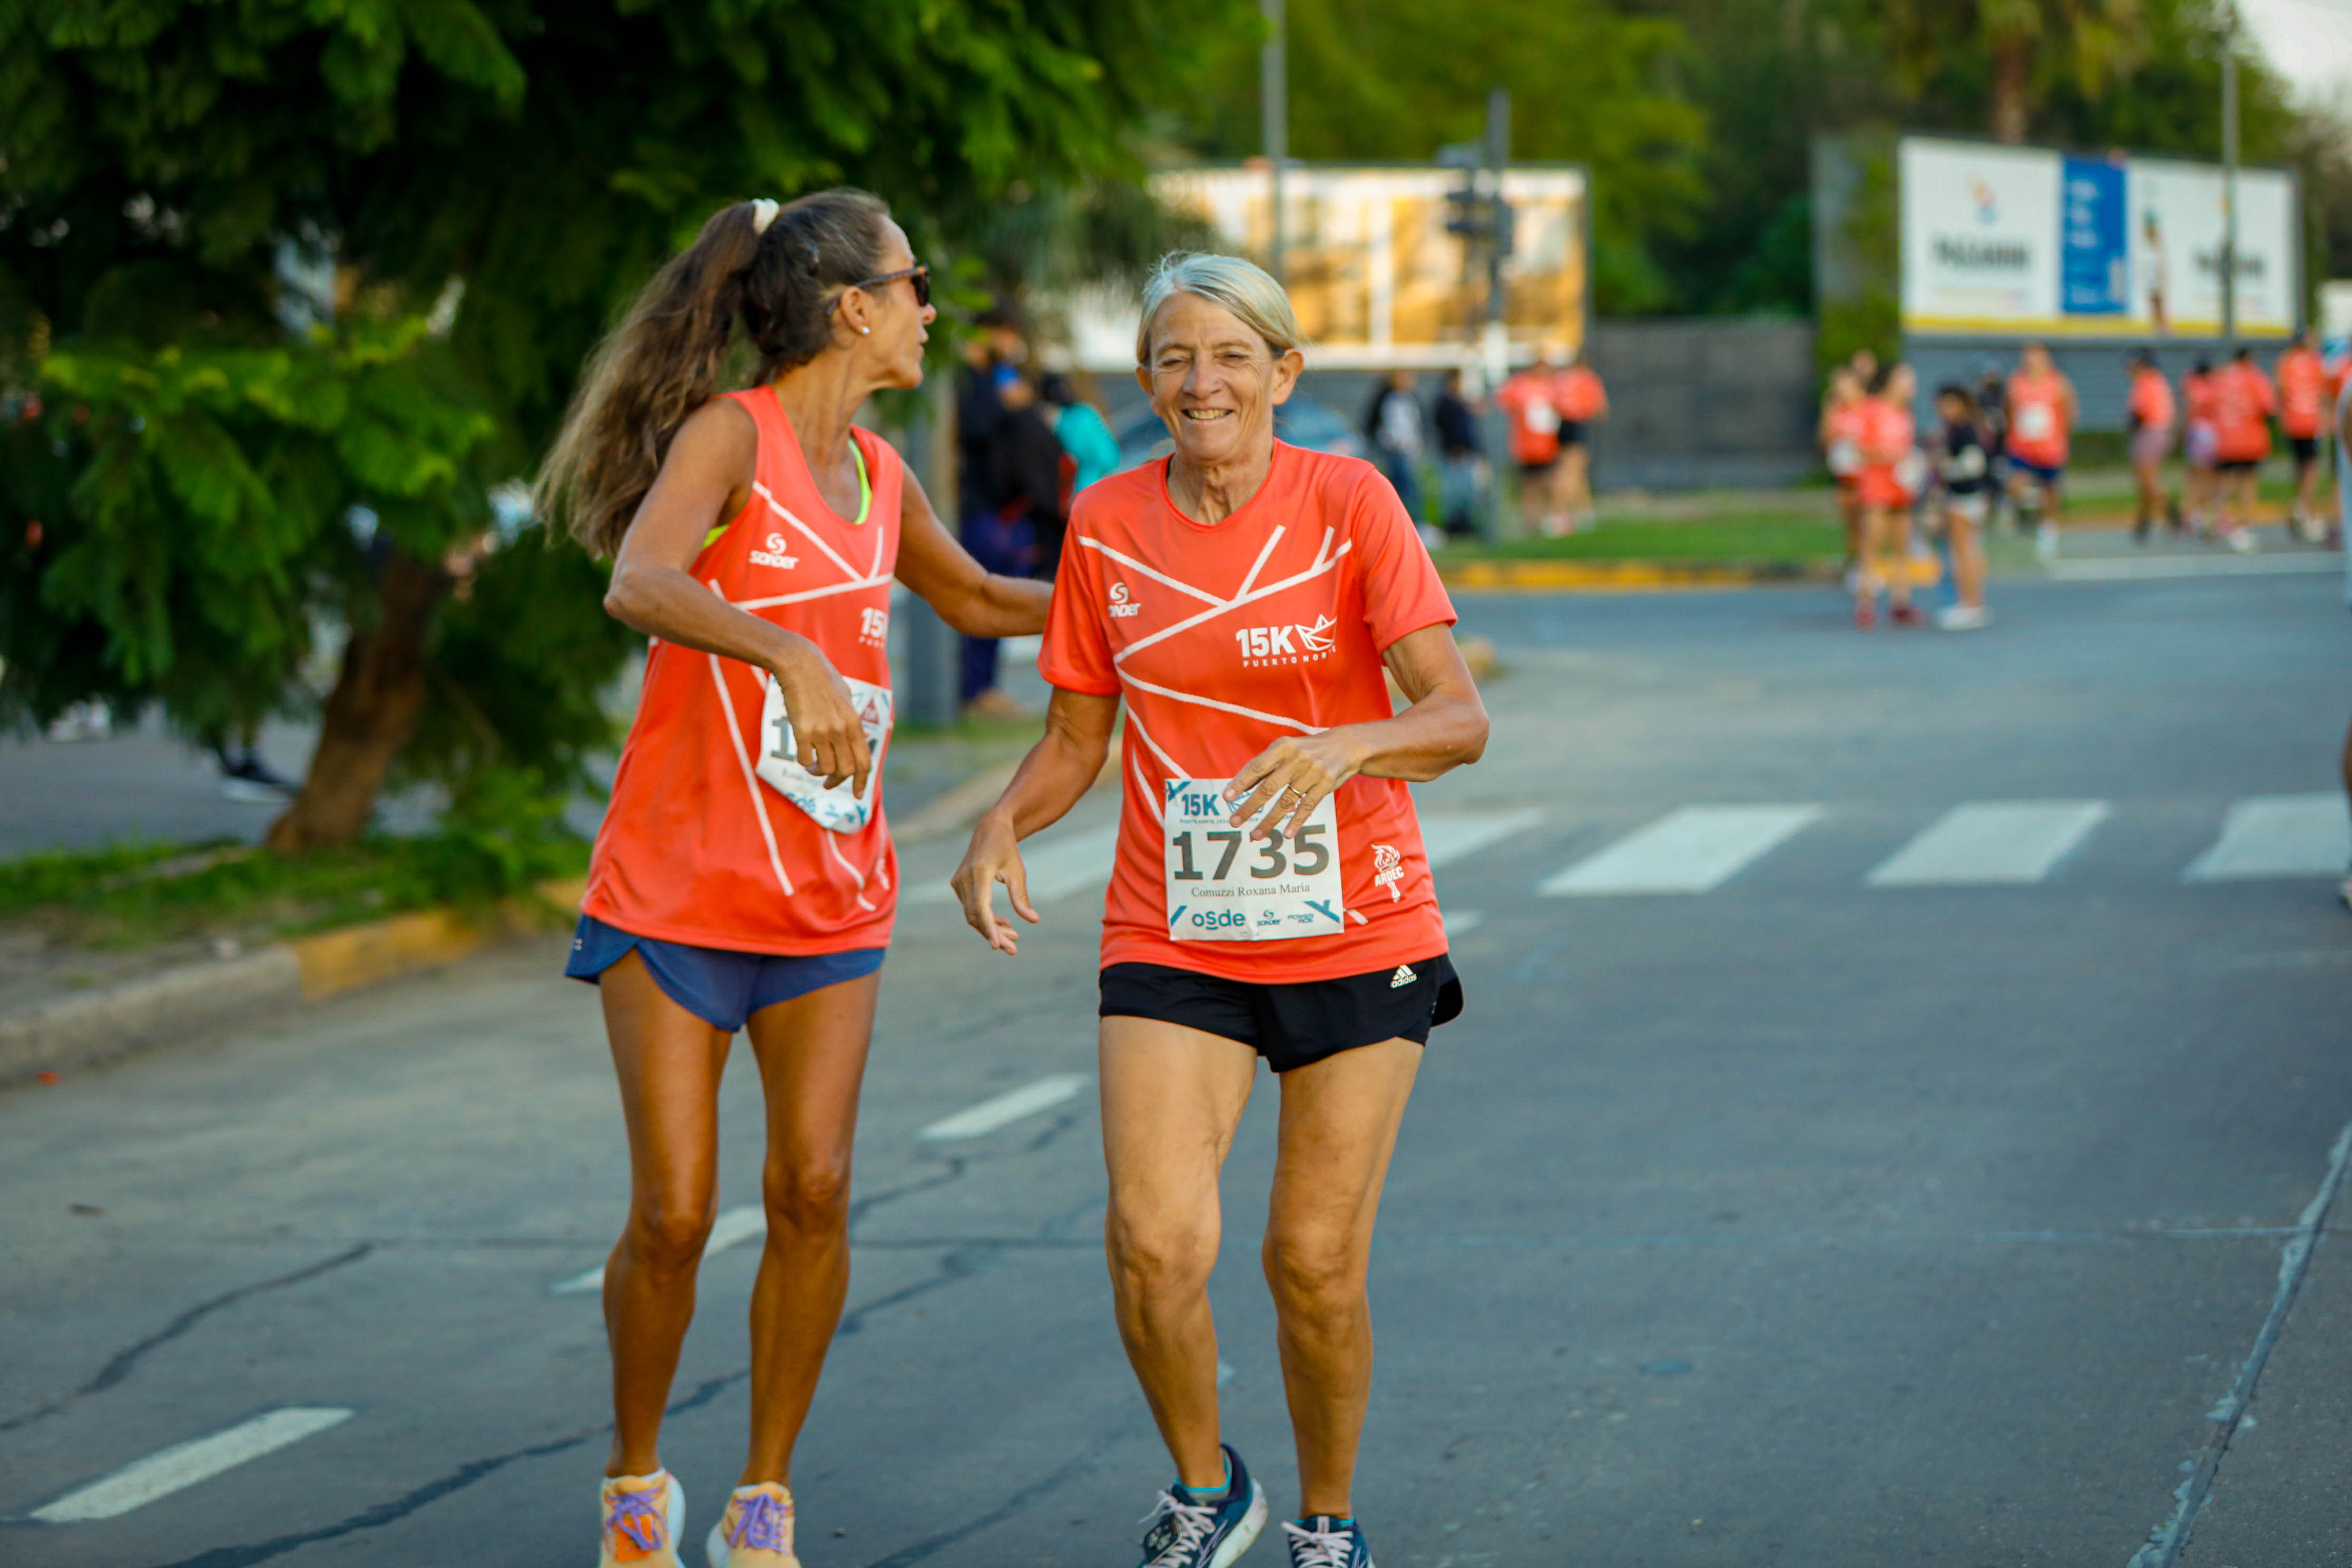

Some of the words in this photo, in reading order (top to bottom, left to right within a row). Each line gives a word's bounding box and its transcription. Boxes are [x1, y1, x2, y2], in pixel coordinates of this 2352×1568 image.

[860, 607, 889, 638] 15
[1235, 625, 1296, 658] 15K
[1243, 657, 1297, 668] PUERTO
[1182, 793, 1220, 816] 15K
[1173, 824, 1329, 880] 1735
[1374, 867, 1404, 887] ARDEC
[1191, 886, 1234, 897] Comuzzi
[1238, 886, 1277, 896] Roxana
[1192, 909, 1246, 929] osde
[1390, 973, 1417, 989] adidas
